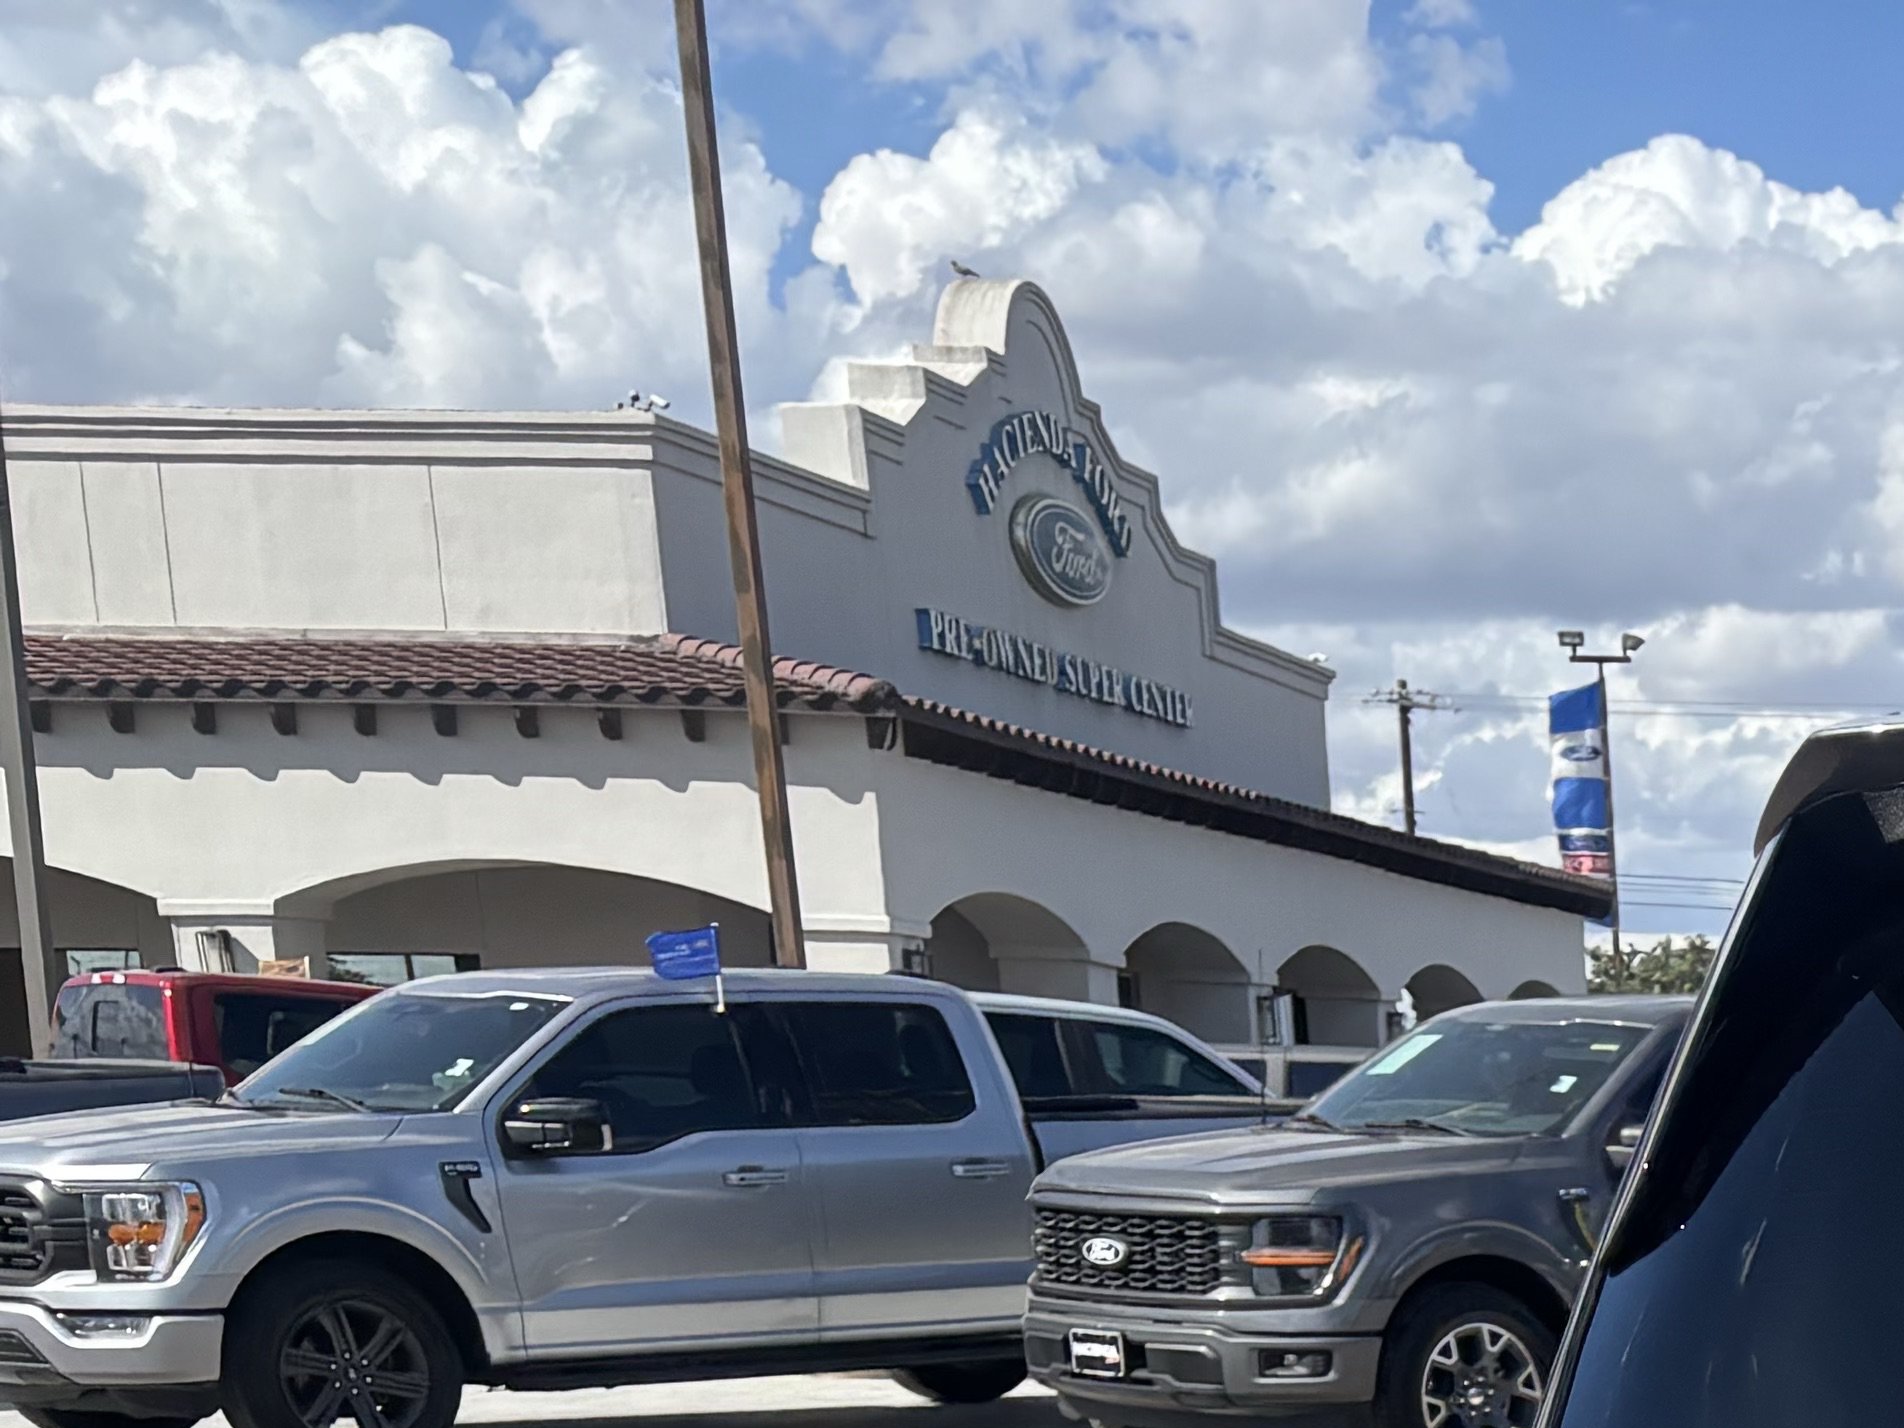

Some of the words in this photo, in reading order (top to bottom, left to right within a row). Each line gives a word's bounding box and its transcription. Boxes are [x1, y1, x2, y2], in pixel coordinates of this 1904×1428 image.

[977, 411, 1077, 512] HACIENDA
[1051, 521, 1098, 586] Ford
[929, 609, 1059, 687] PRE-OWNED
[1064, 653, 1125, 707] SUPER
[1129, 676, 1193, 729] CENTER
